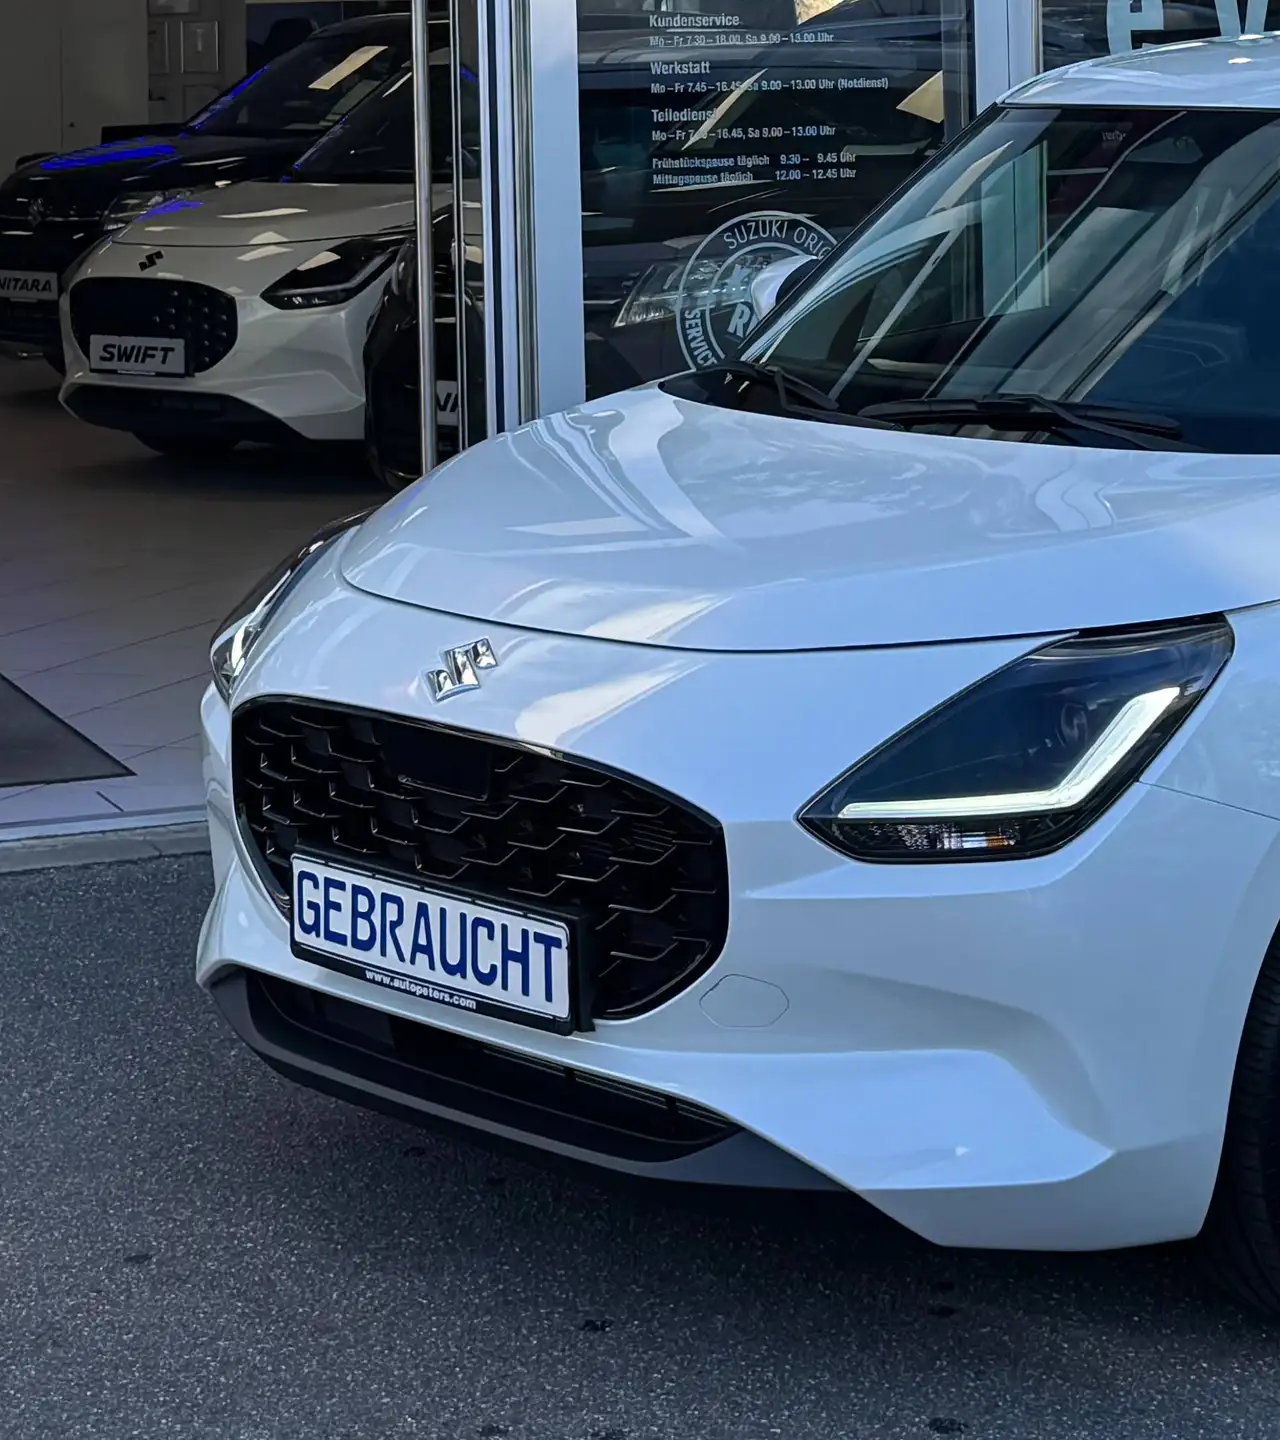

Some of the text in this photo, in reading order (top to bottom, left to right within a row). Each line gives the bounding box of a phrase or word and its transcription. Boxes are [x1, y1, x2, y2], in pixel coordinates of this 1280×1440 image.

[649, 14, 740, 28] Kundenservice
[746, 34, 758, 44] Sa
[818, 33, 835, 43] Uhr
[650, 61, 710, 75] Werkstatt
[819, 78, 834, 89] Uhr
[837, 77, 889, 90] (Notdienst)
[747, 127, 760, 138] Sa
[820, 125, 836, 136] Uhr
[652, 156, 735, 170] Frühstückspause
[737, 155, 770, 168] täglich
[780, 154, 801, 165] 9.30
[817, 152, 838, 163] 9.45
[840, 152, 857, 162] Uhr
[652, 172, 719, 186] Mittagspause
[720, 171, 754, 184] täglich
[775, 169, 801, 180] 12.00
[812, 169, 838, 180] 12.45
[840, 168, 857, 178] Uhr
[723, 219, 789, 250] SUZUKI
[99, 344, 175, 365] SWIFT
[296, 869, 563, 1003] GEBRAUCHT
[365, 968, 478, 1011] www.autopeters.com
